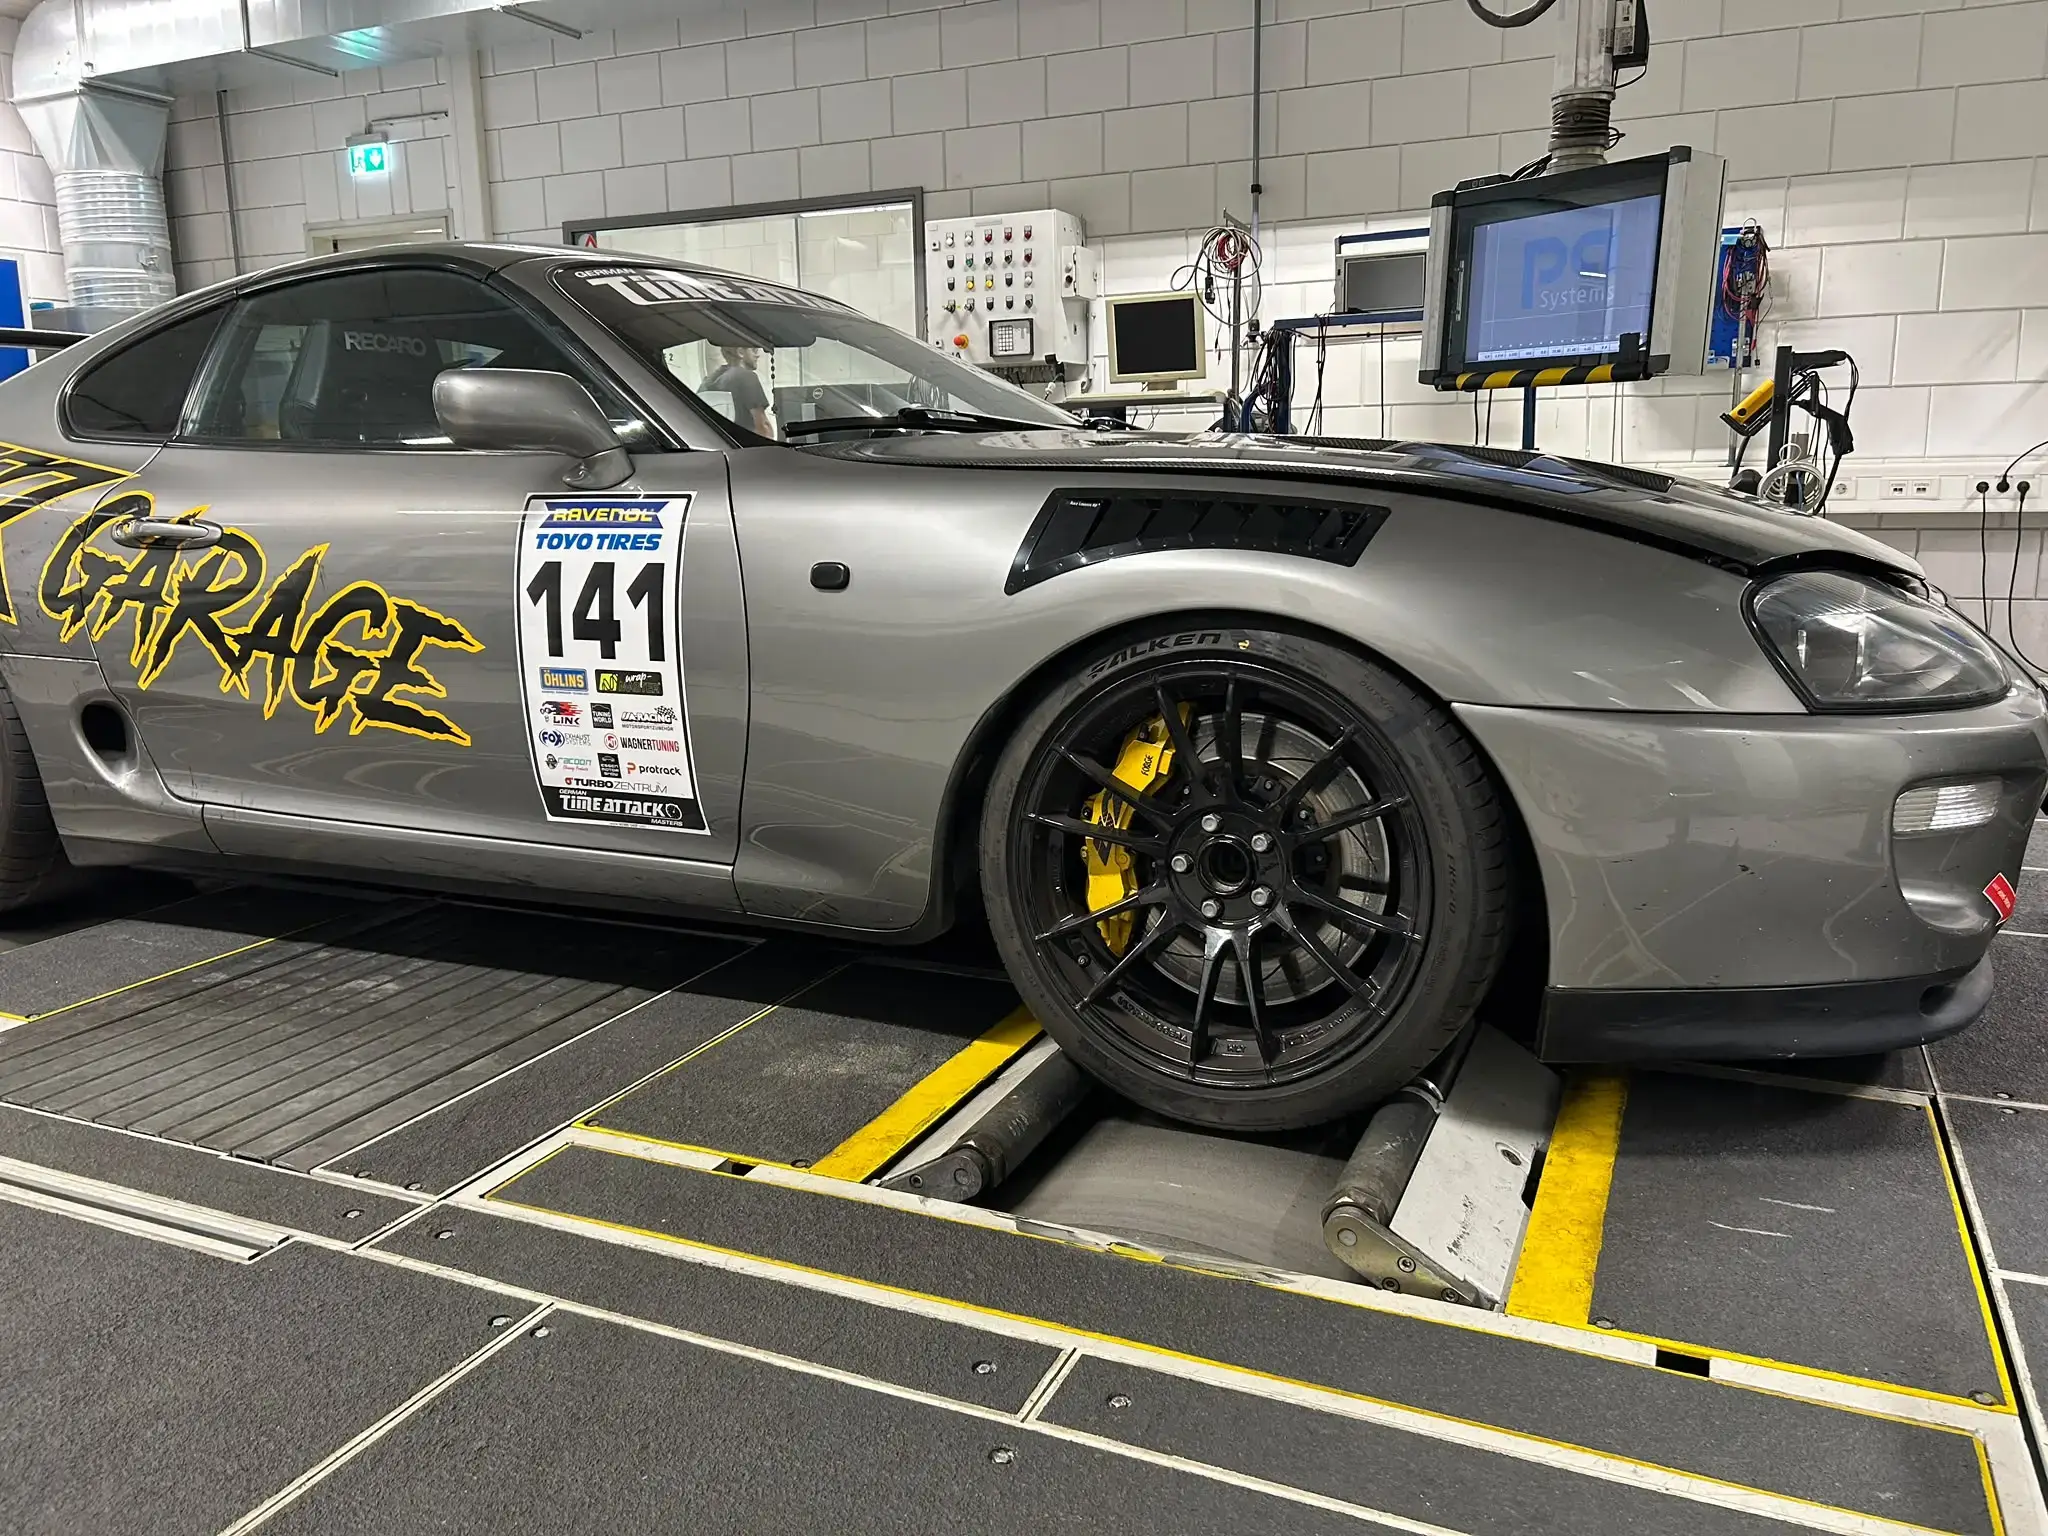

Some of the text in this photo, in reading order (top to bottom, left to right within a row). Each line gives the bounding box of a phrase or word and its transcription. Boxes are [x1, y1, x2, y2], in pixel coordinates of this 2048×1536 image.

[575, 268, 636, 278] GERMAN
[1540, 285, 1615, 311] Systems
[344, 331, 427, 357] RECARO
[553, 507, 653, 522] RAVENOL
[536, 533, 662, 550] TOYO TIRES
[38, 490, 486, 747] GARAGE
[526, 561, 665, 662] 141
[543, 670, 584, 688] ÖHLINS
[620, 737, 679, 752] WAGNERTUNING
[639, 765, 682, 776] protrack
[559, 788, 587, 796] GERMAN
[573, 777, 667, 794] TURBOZENTRUM
[651, 818, 683, 827] MASTERS
